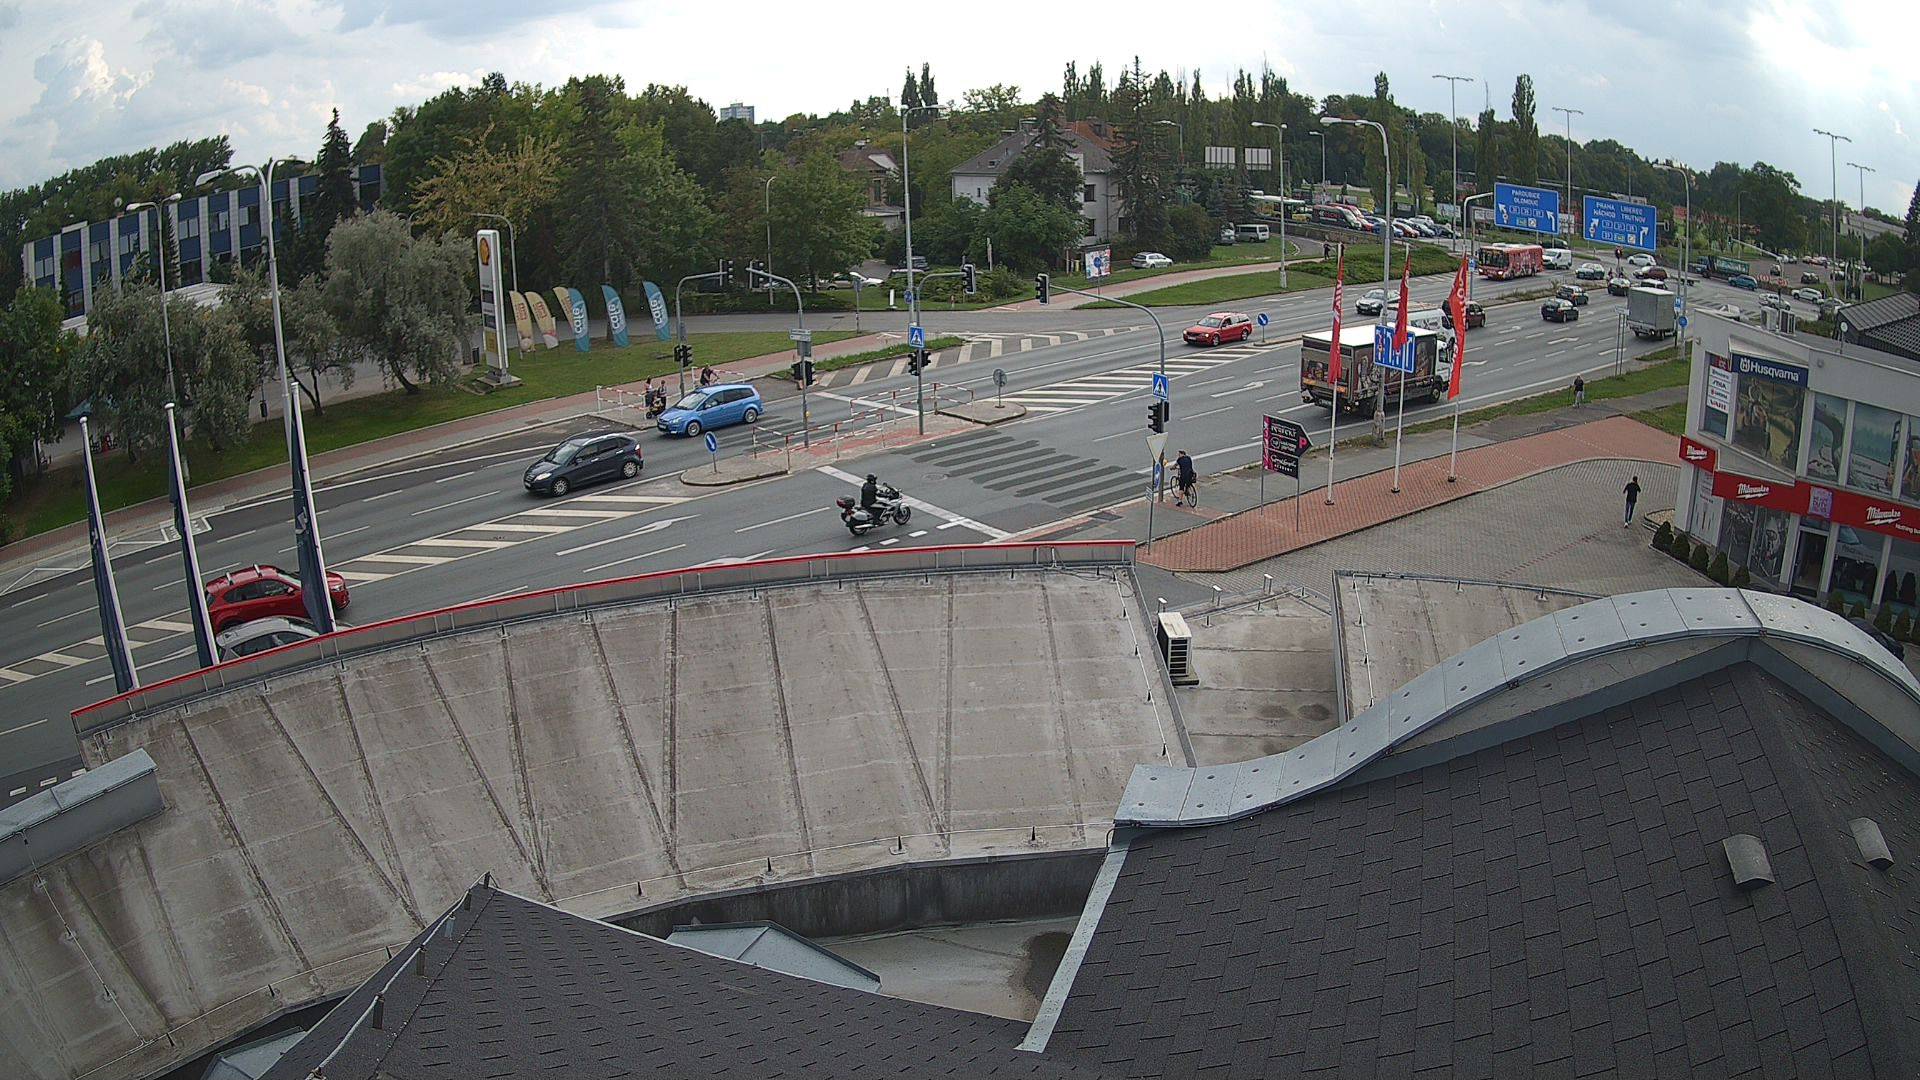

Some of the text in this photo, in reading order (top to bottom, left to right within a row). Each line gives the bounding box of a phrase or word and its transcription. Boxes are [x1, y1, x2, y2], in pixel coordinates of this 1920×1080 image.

[1750, 362, 1799, 382] Husqvarna
[1299, 437, 1308, 448] P
[1737, 483, 1770, 496] Milwaukee
[1866, 506, 1901, 520] Milwaukee
